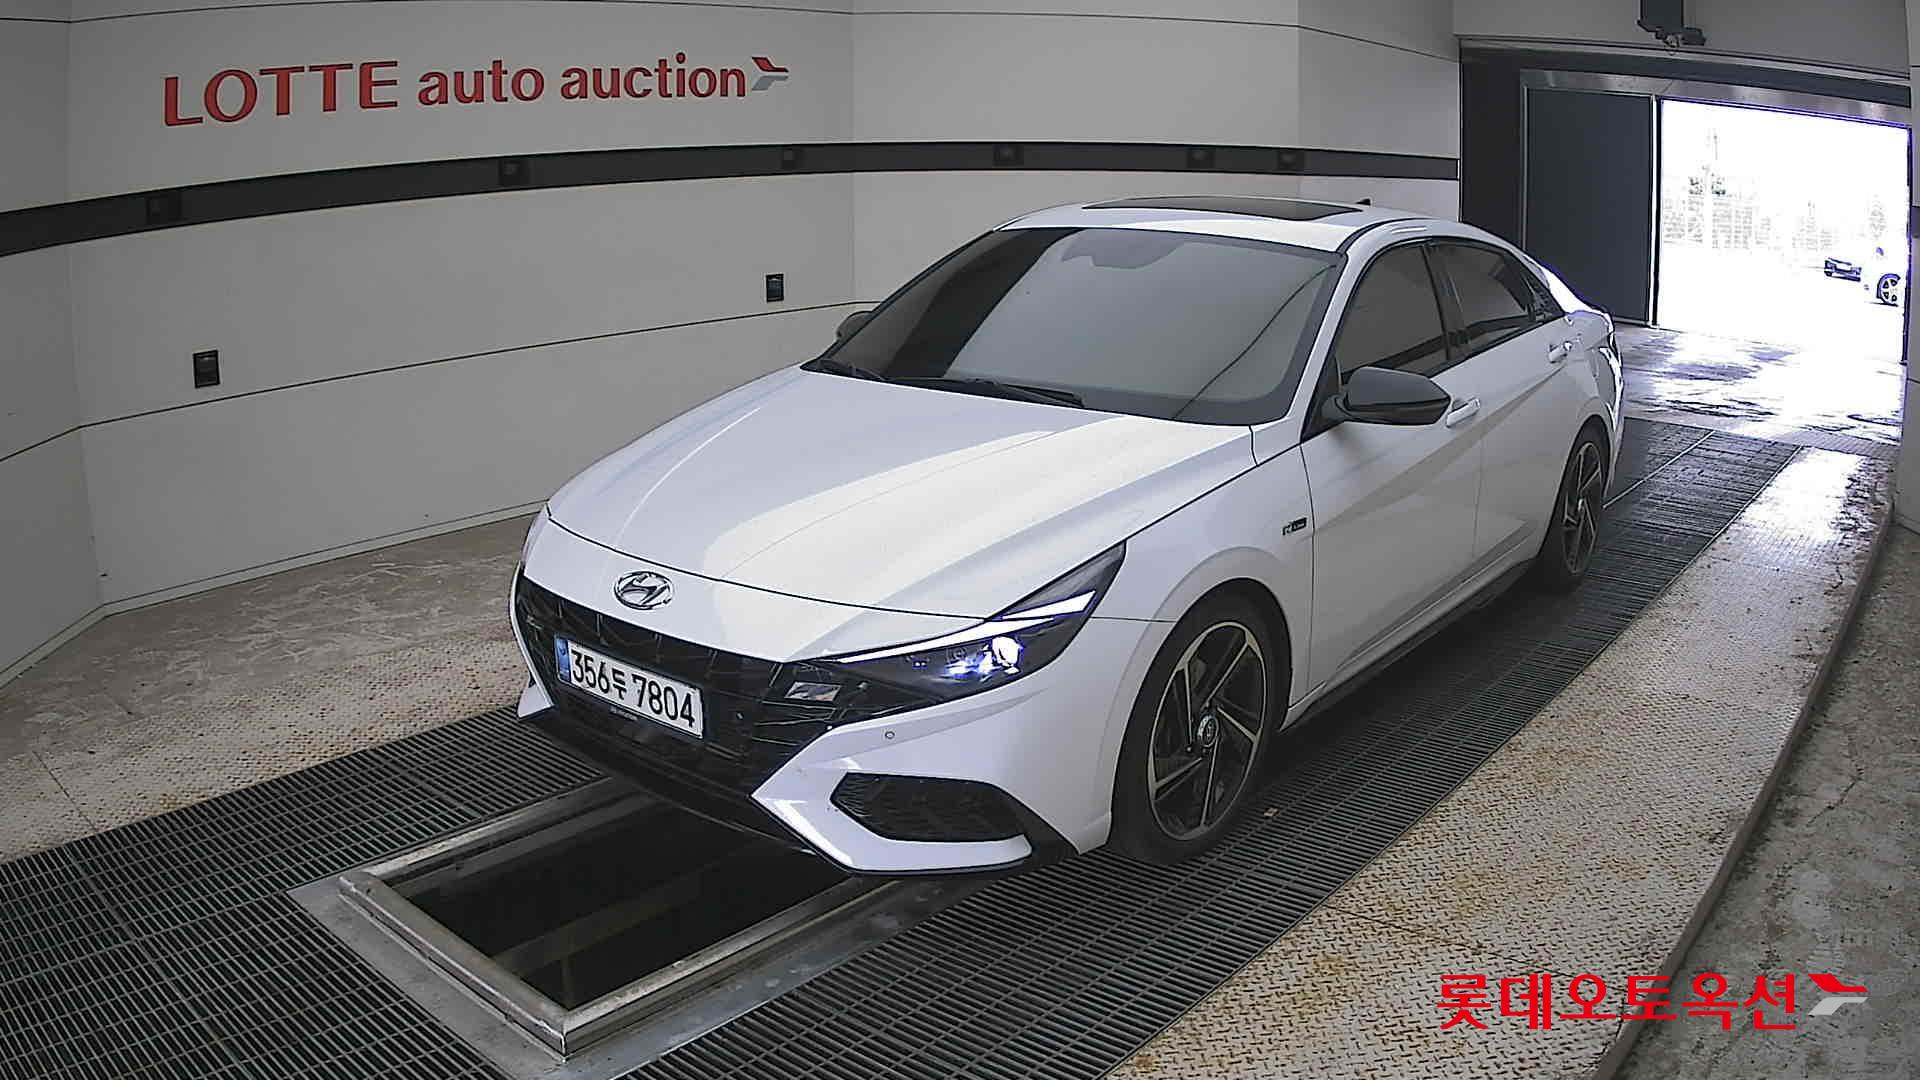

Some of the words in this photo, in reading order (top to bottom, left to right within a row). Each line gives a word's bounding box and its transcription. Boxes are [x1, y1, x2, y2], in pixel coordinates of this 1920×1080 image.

[164, 60, 399, 127] LOTTE
[418, 59, 544, 106] auto
[561, 52, 746, 101] auction
[571, 650, 627, 700] 356두
[631, 673, 696, 728] 7804
